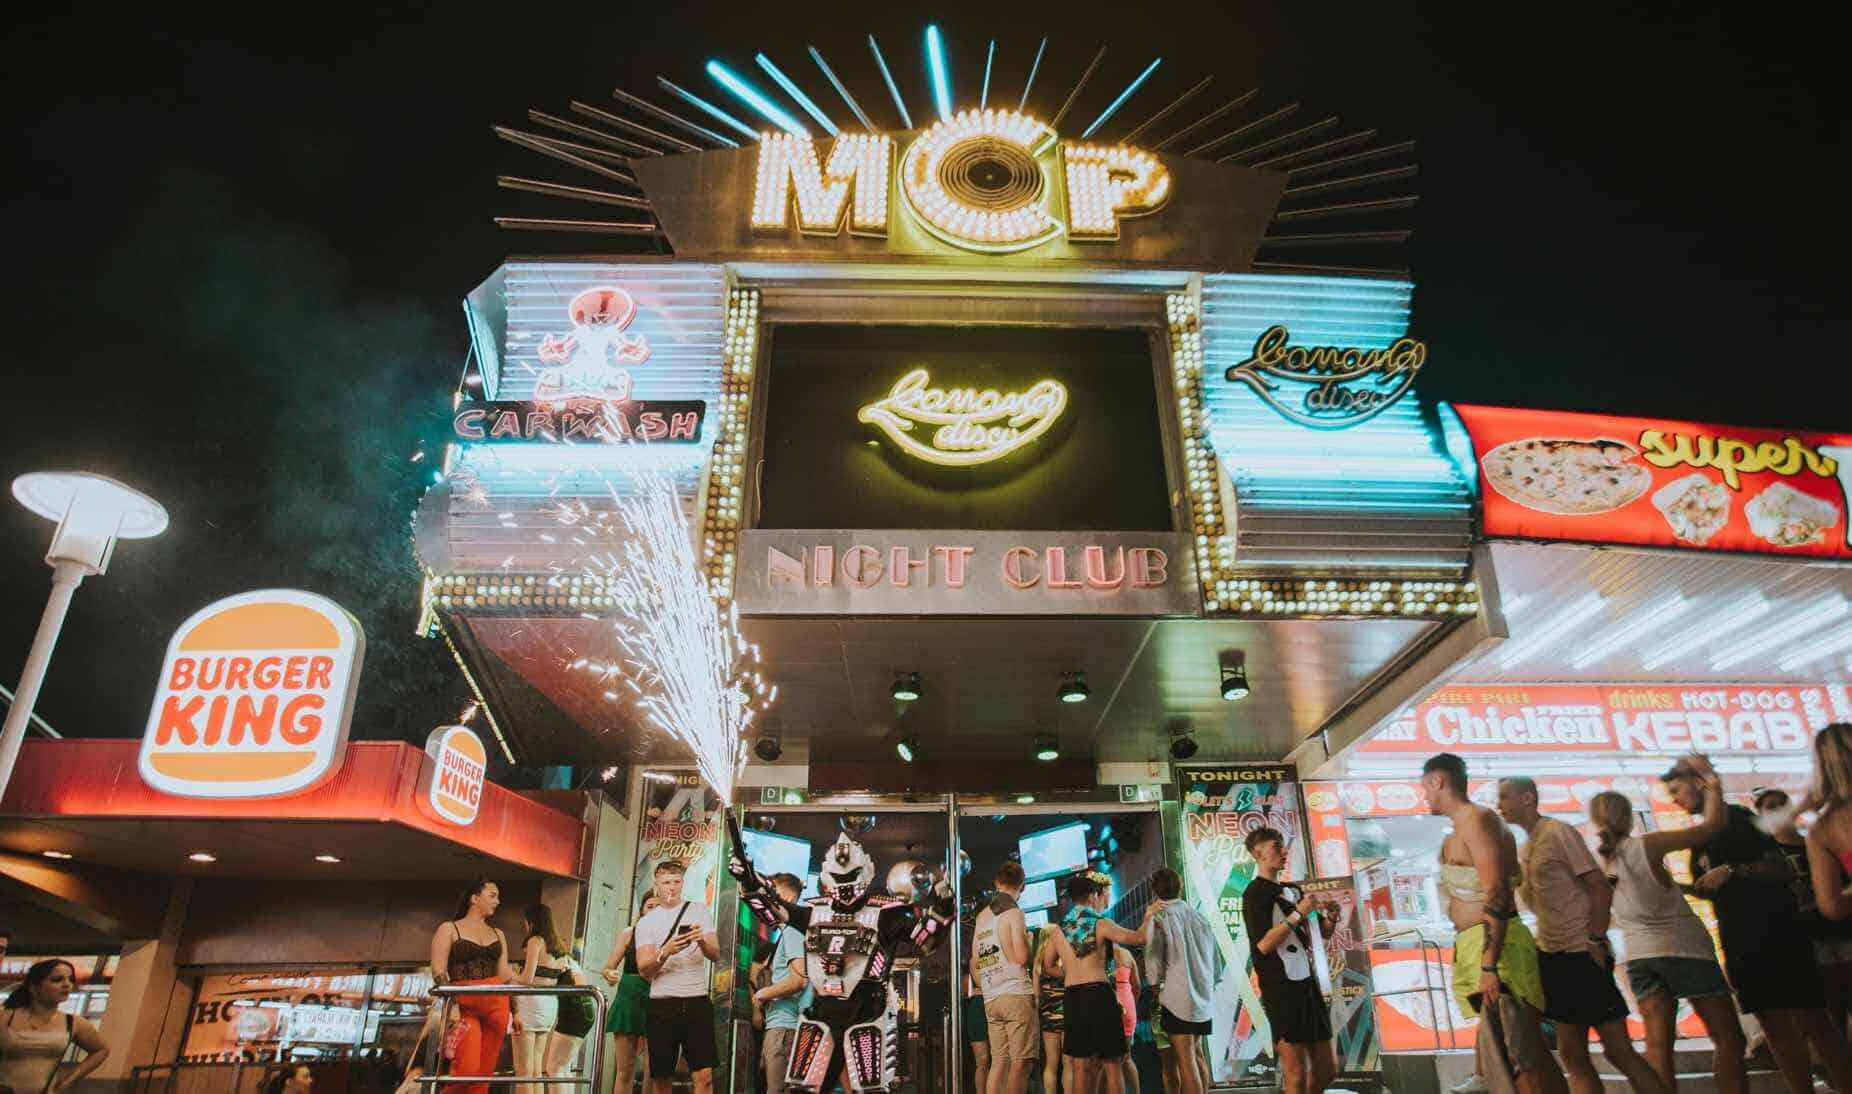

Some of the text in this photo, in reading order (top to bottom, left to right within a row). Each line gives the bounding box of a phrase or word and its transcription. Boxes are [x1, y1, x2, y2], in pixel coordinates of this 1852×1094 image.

[751, 107, 1171, 252] MCP
[767, 545, 1170, 591] NIGHT CLUB
[168, 655, 336, 691] BURGER
[1608, 689, 1674, 709] drinks
[1680, 688, 1795, 711] HOT-DOG
[155, 694, 326, 746] KING
[1425, 705, 1610, 745] Chicken
[1611, 711, 1809, 751] KEBAB
[444, 750, 483, 781] BURGER
[1185, 770, 1286, 781] TONIGHT
[439, 767, 480, 806] KING
[644, 822, 717, 841] NEON
[1187, 811, 1297, 840] NEON
[651, 839, 704, 864] Party
[827, 935, 846, 955] R
